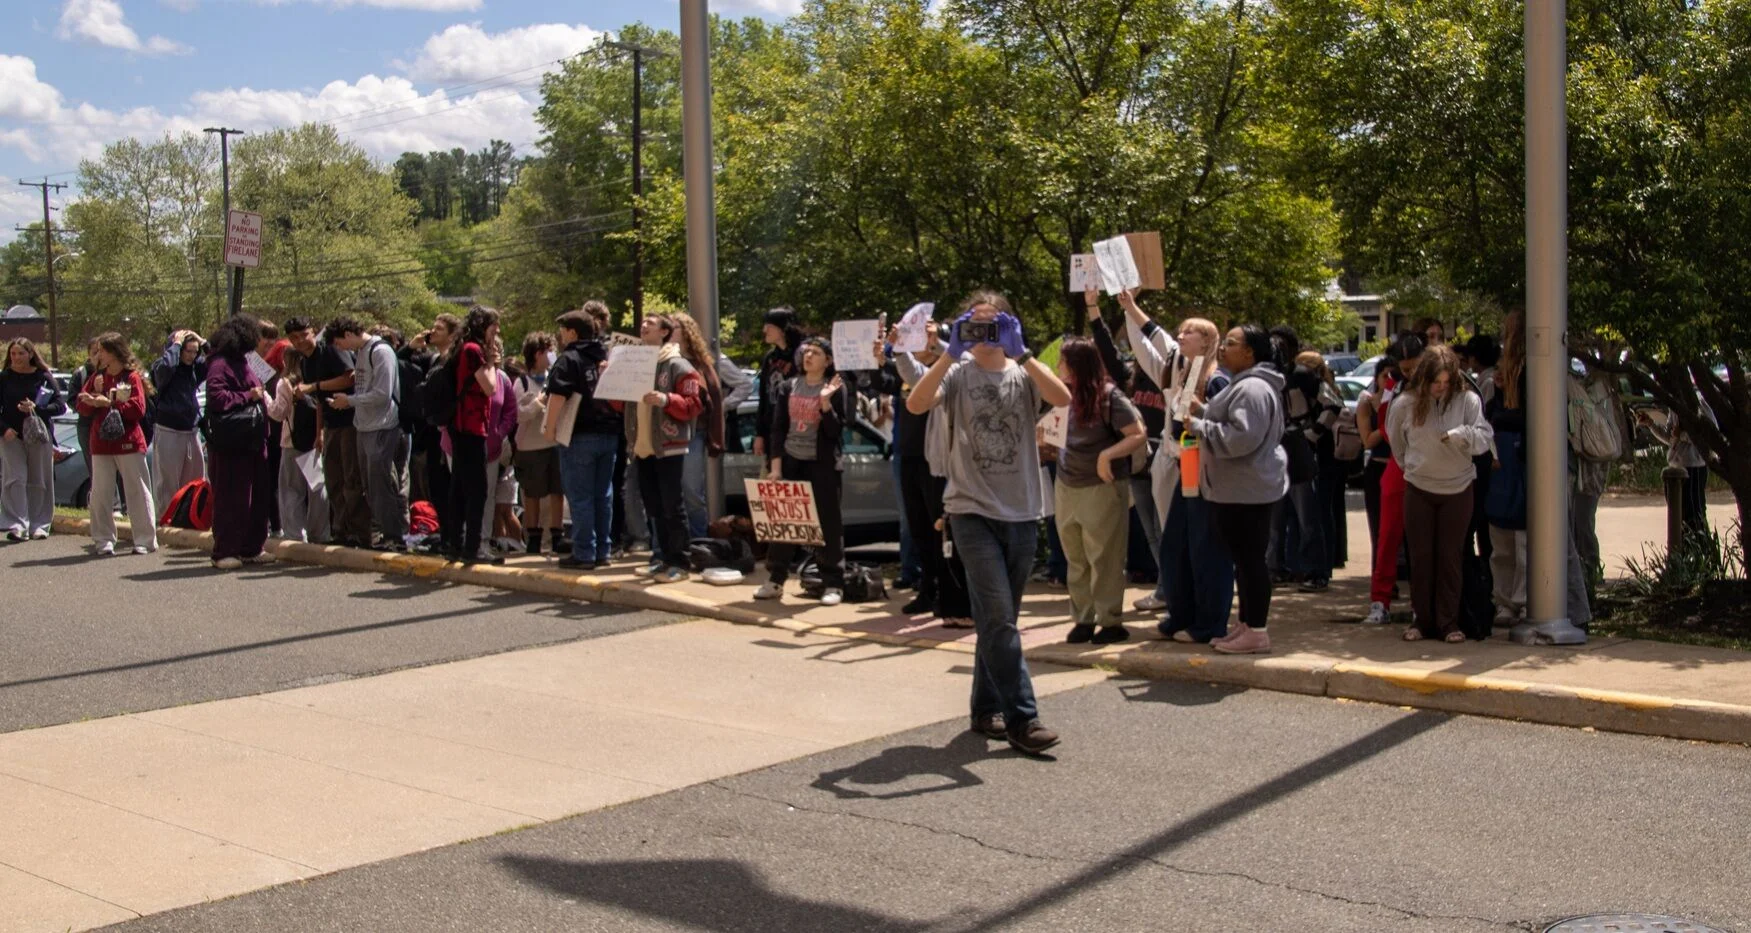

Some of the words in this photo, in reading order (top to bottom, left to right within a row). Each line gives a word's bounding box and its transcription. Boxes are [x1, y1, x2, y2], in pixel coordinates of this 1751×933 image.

[231, 224, 259, 236] PARKING
[230, 237, 259, 248] STANDING
[228, 246, 258, 257] FIRELANE
[757, 482, 810, 497] REPEAL
[764, 499, 811, 520] UNJUST
